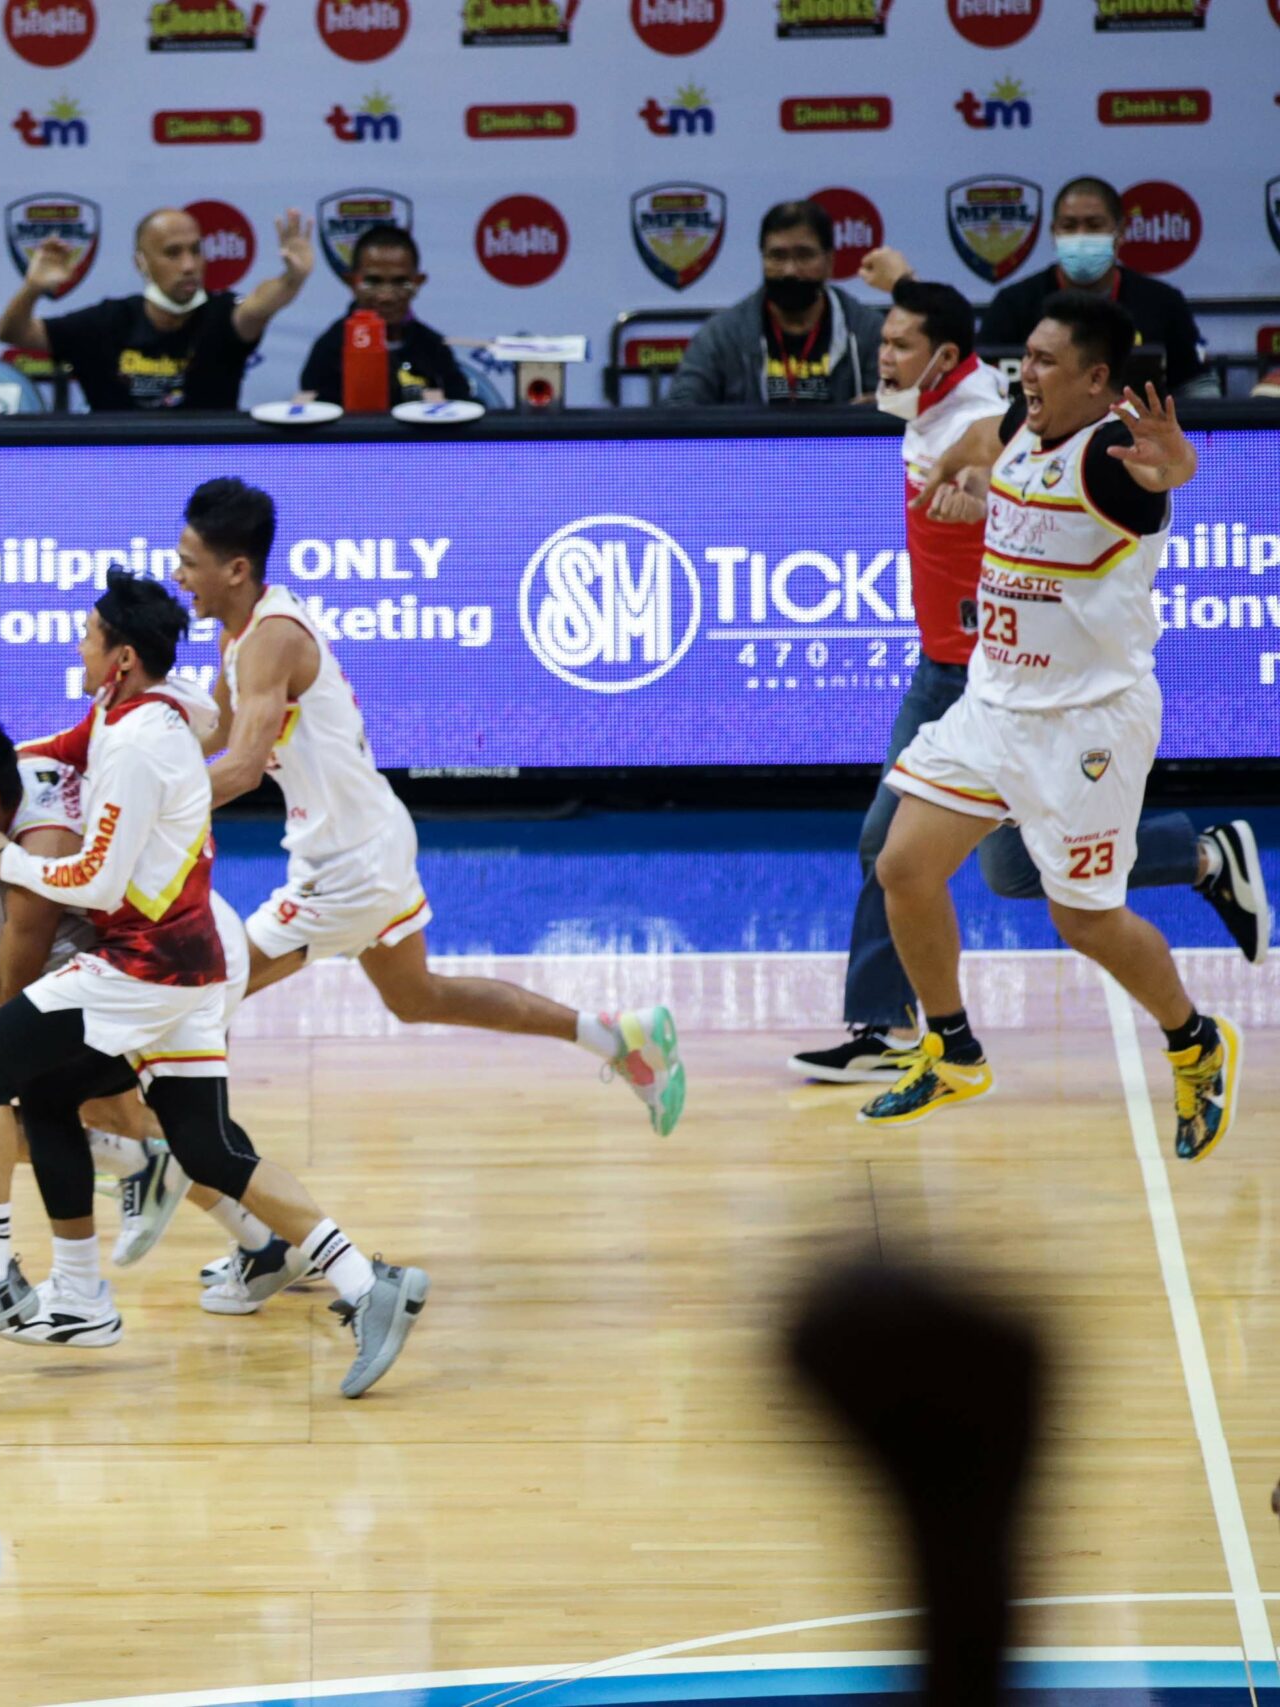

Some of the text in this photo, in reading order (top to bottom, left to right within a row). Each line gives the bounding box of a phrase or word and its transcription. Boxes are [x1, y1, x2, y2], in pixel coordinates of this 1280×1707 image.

[14, 108, 87, 147] tm
[327, 104, 400, 141] tm
[639, 98, 715, 137] tm
[955, 91, 1032, 129] tm
[352, 325, 371, 348] 5
[289, 538, 450, 580] ONLY
[536, 537, 670, 667] SM
[997, 573, 1063, 593] PLASTIC
[306, 595, 492, 647] keting
[982, 601, 1018, 647] 23
[984, 644, 1052, 668] SILAN
[1068, 841, 1115, 880] 23
